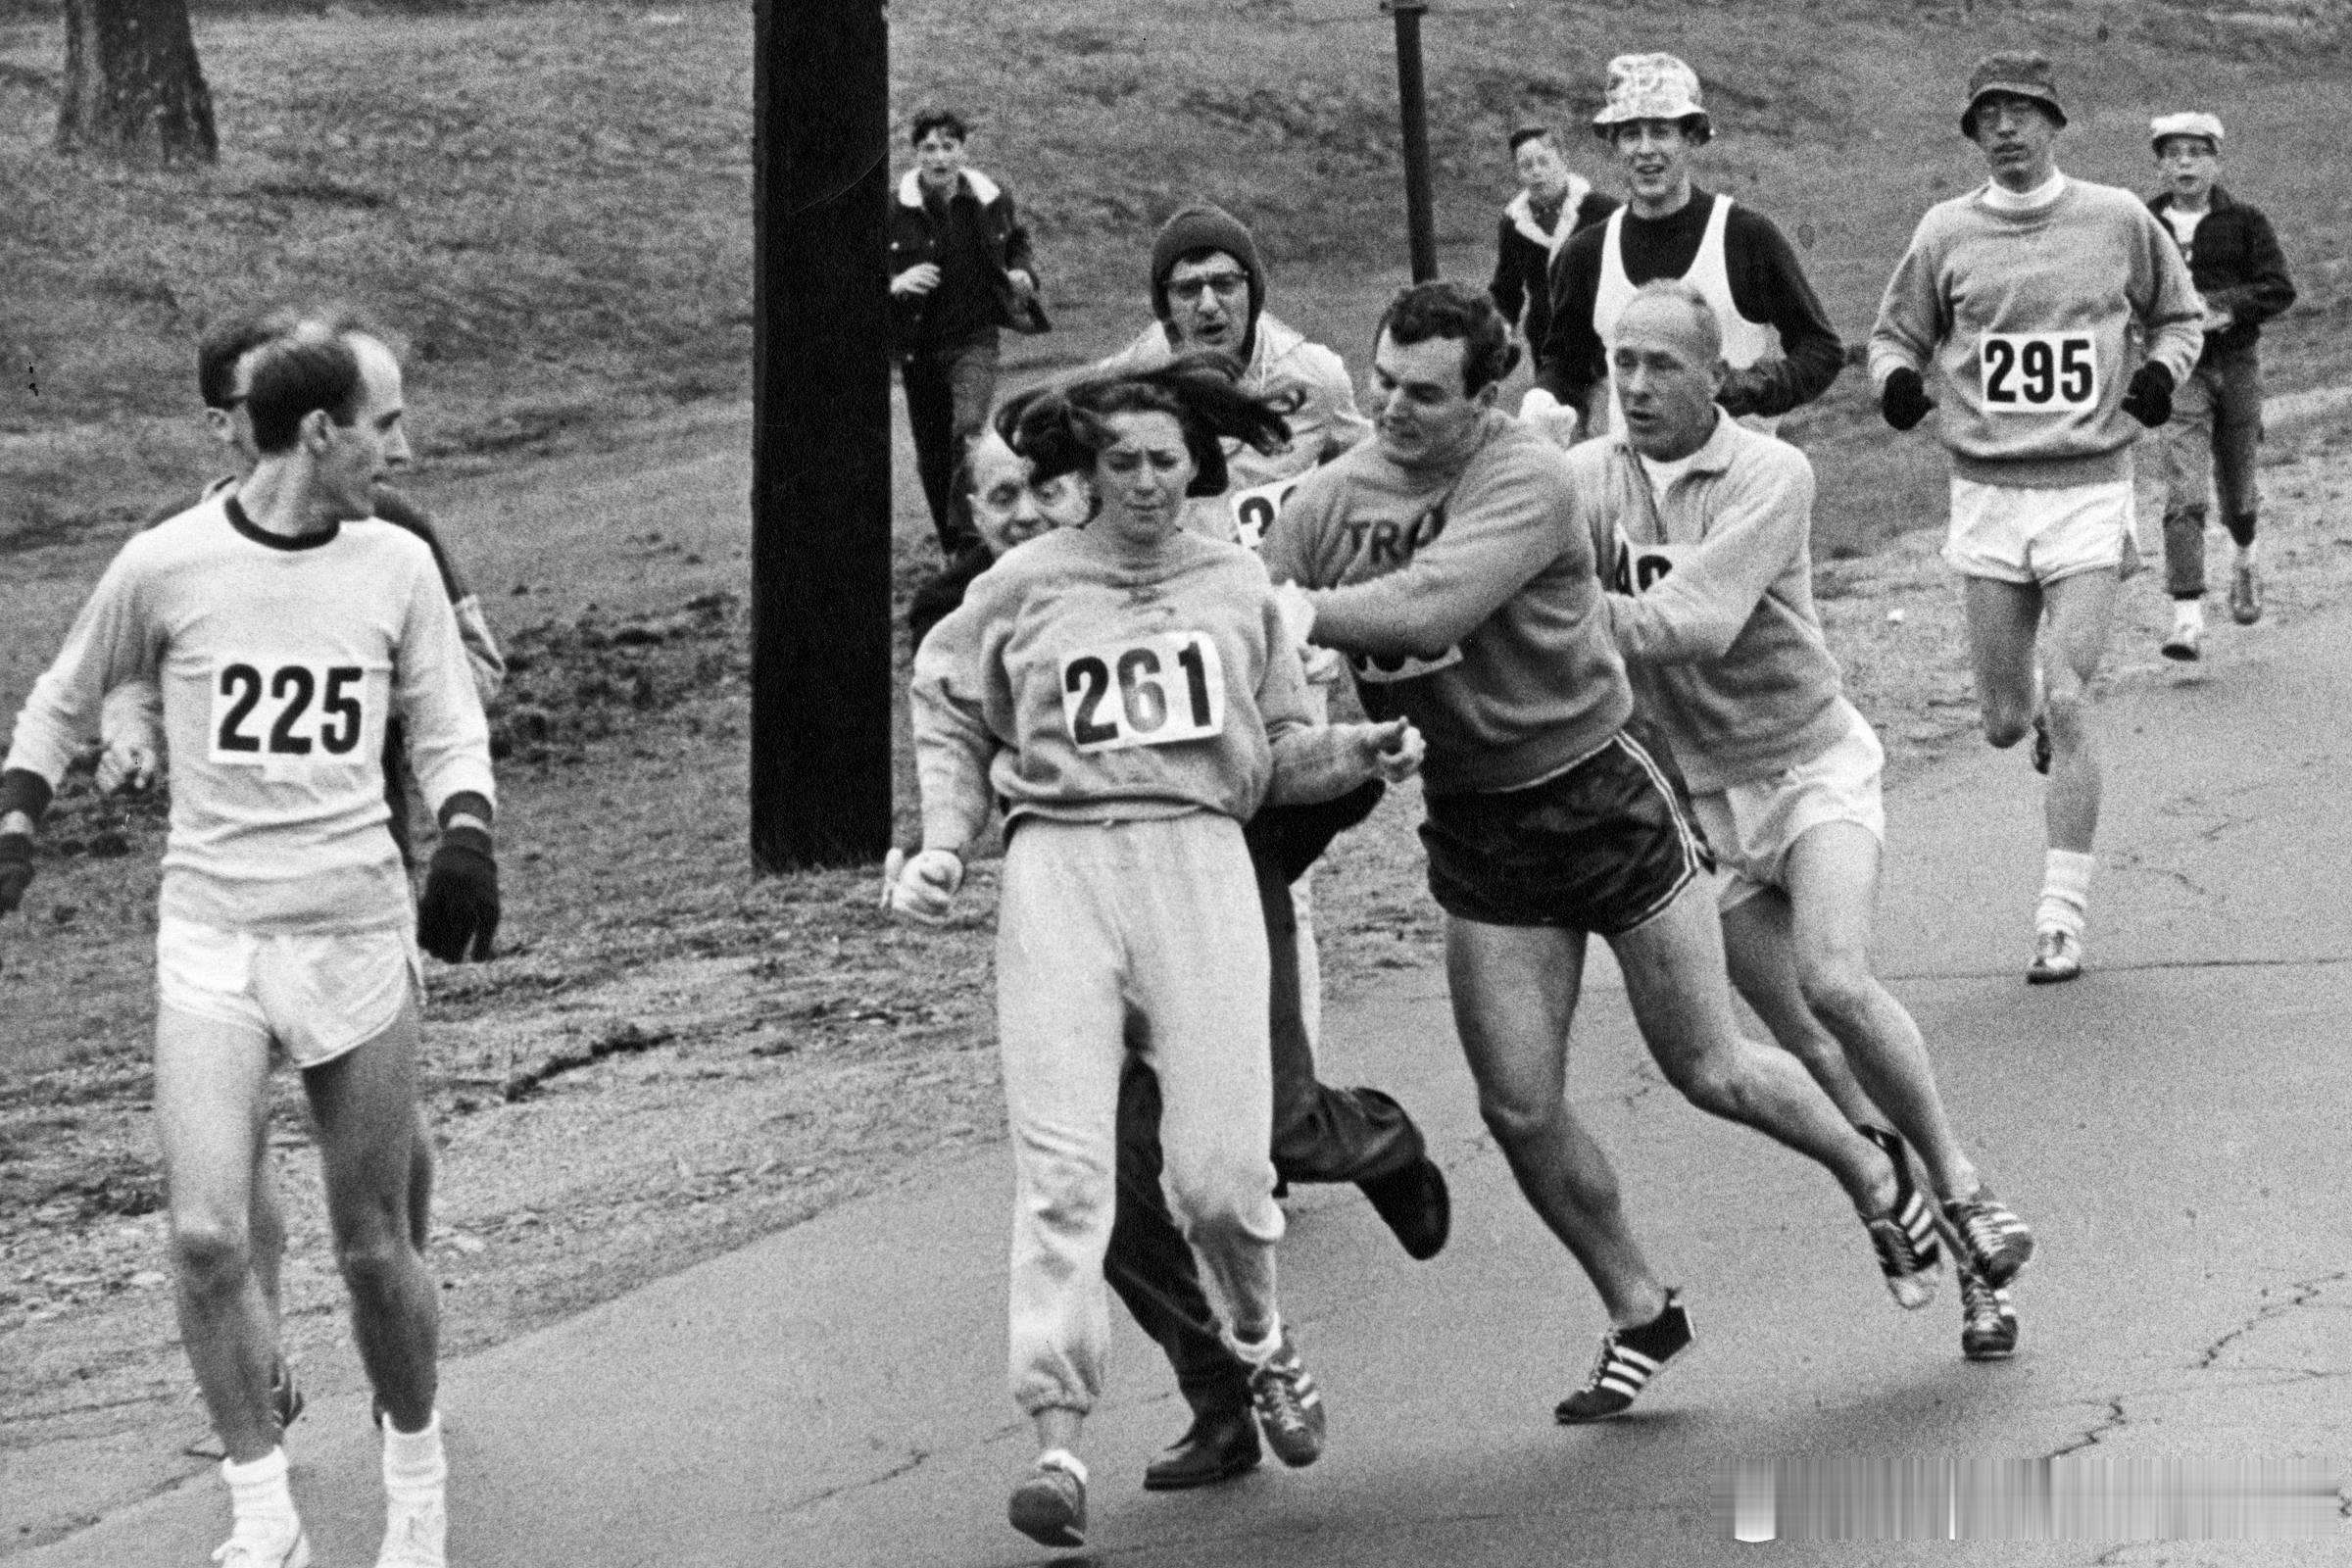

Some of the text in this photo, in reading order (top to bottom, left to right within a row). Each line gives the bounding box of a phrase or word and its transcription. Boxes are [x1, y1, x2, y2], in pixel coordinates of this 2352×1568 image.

[1984, 339, 2093, 404] 295
[218, 662, 363, 755] 225
[1065, 641, 1212, 746] 261
